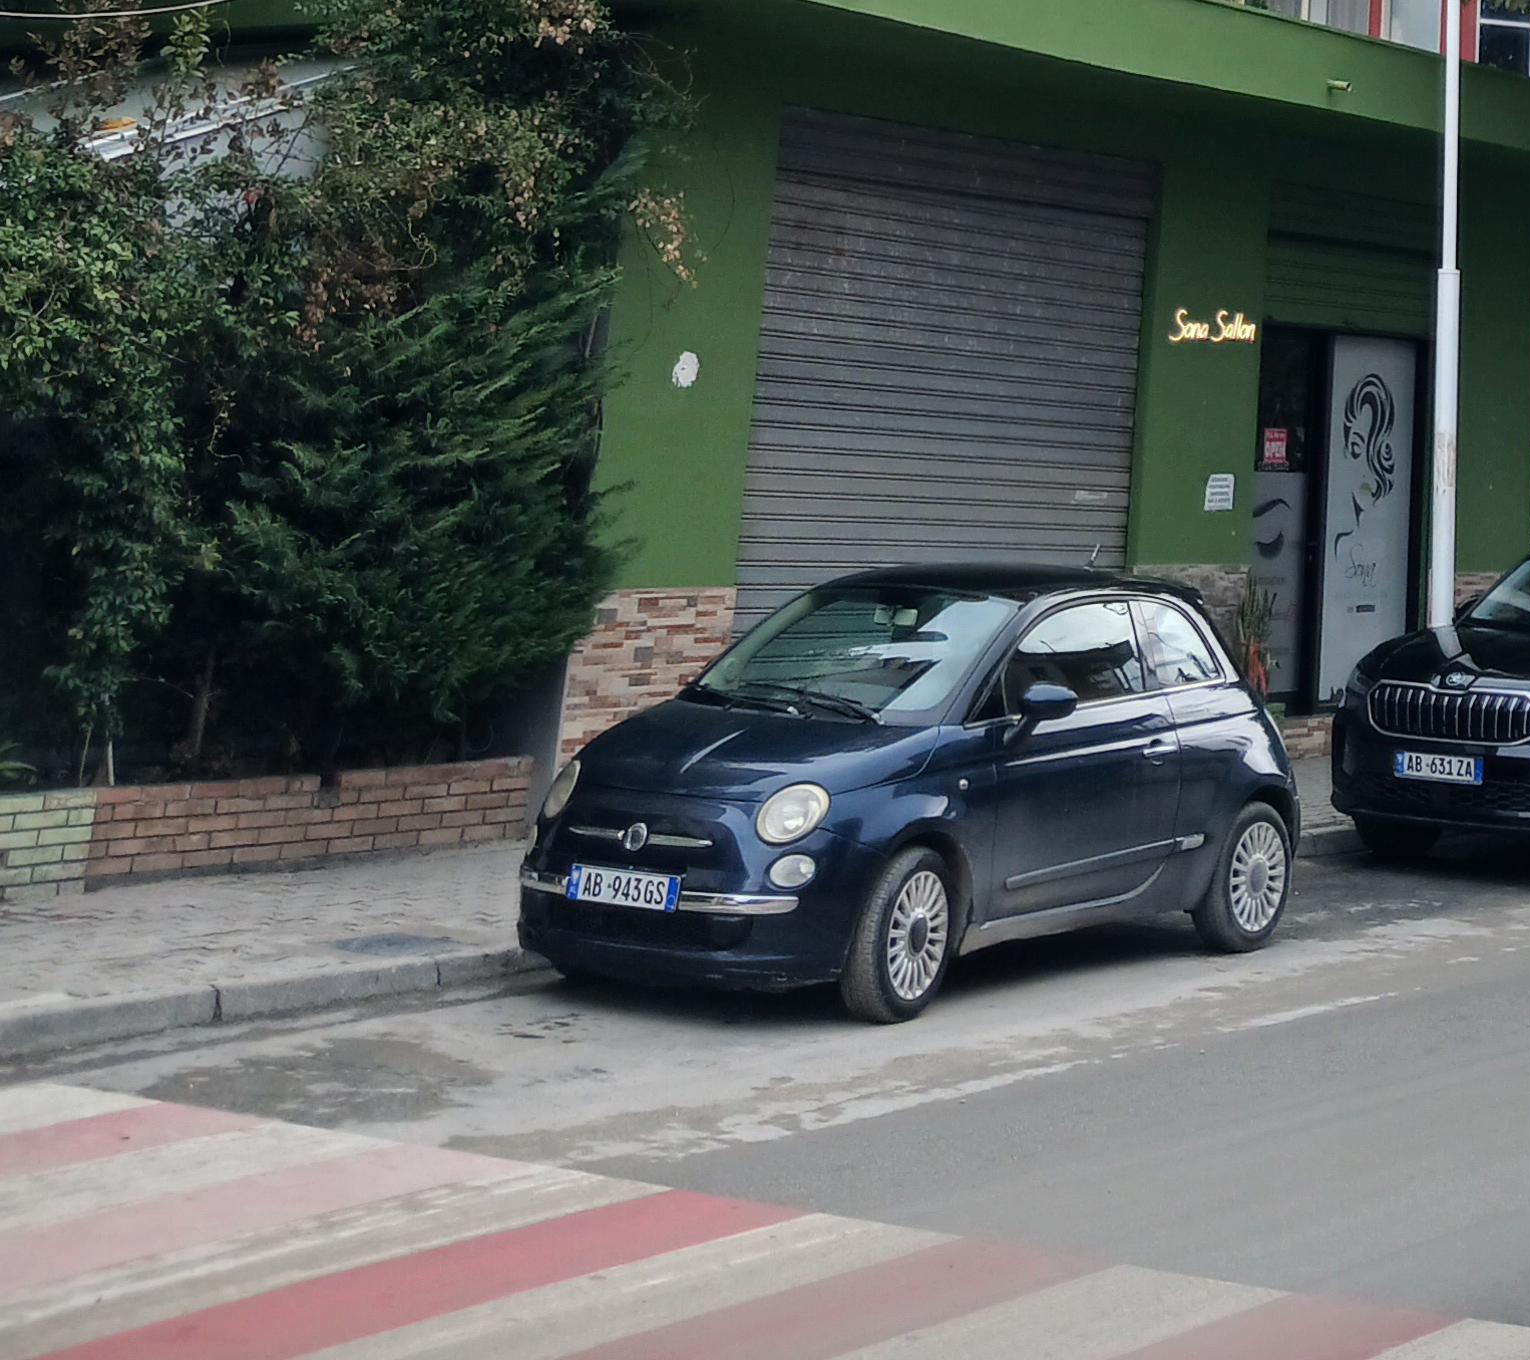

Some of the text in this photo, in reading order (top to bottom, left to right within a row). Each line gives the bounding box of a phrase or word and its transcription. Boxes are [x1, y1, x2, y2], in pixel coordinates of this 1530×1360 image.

[1407, 754, 1473, 778] AB 631 ZA
[582, 872, 604, 897] AB
